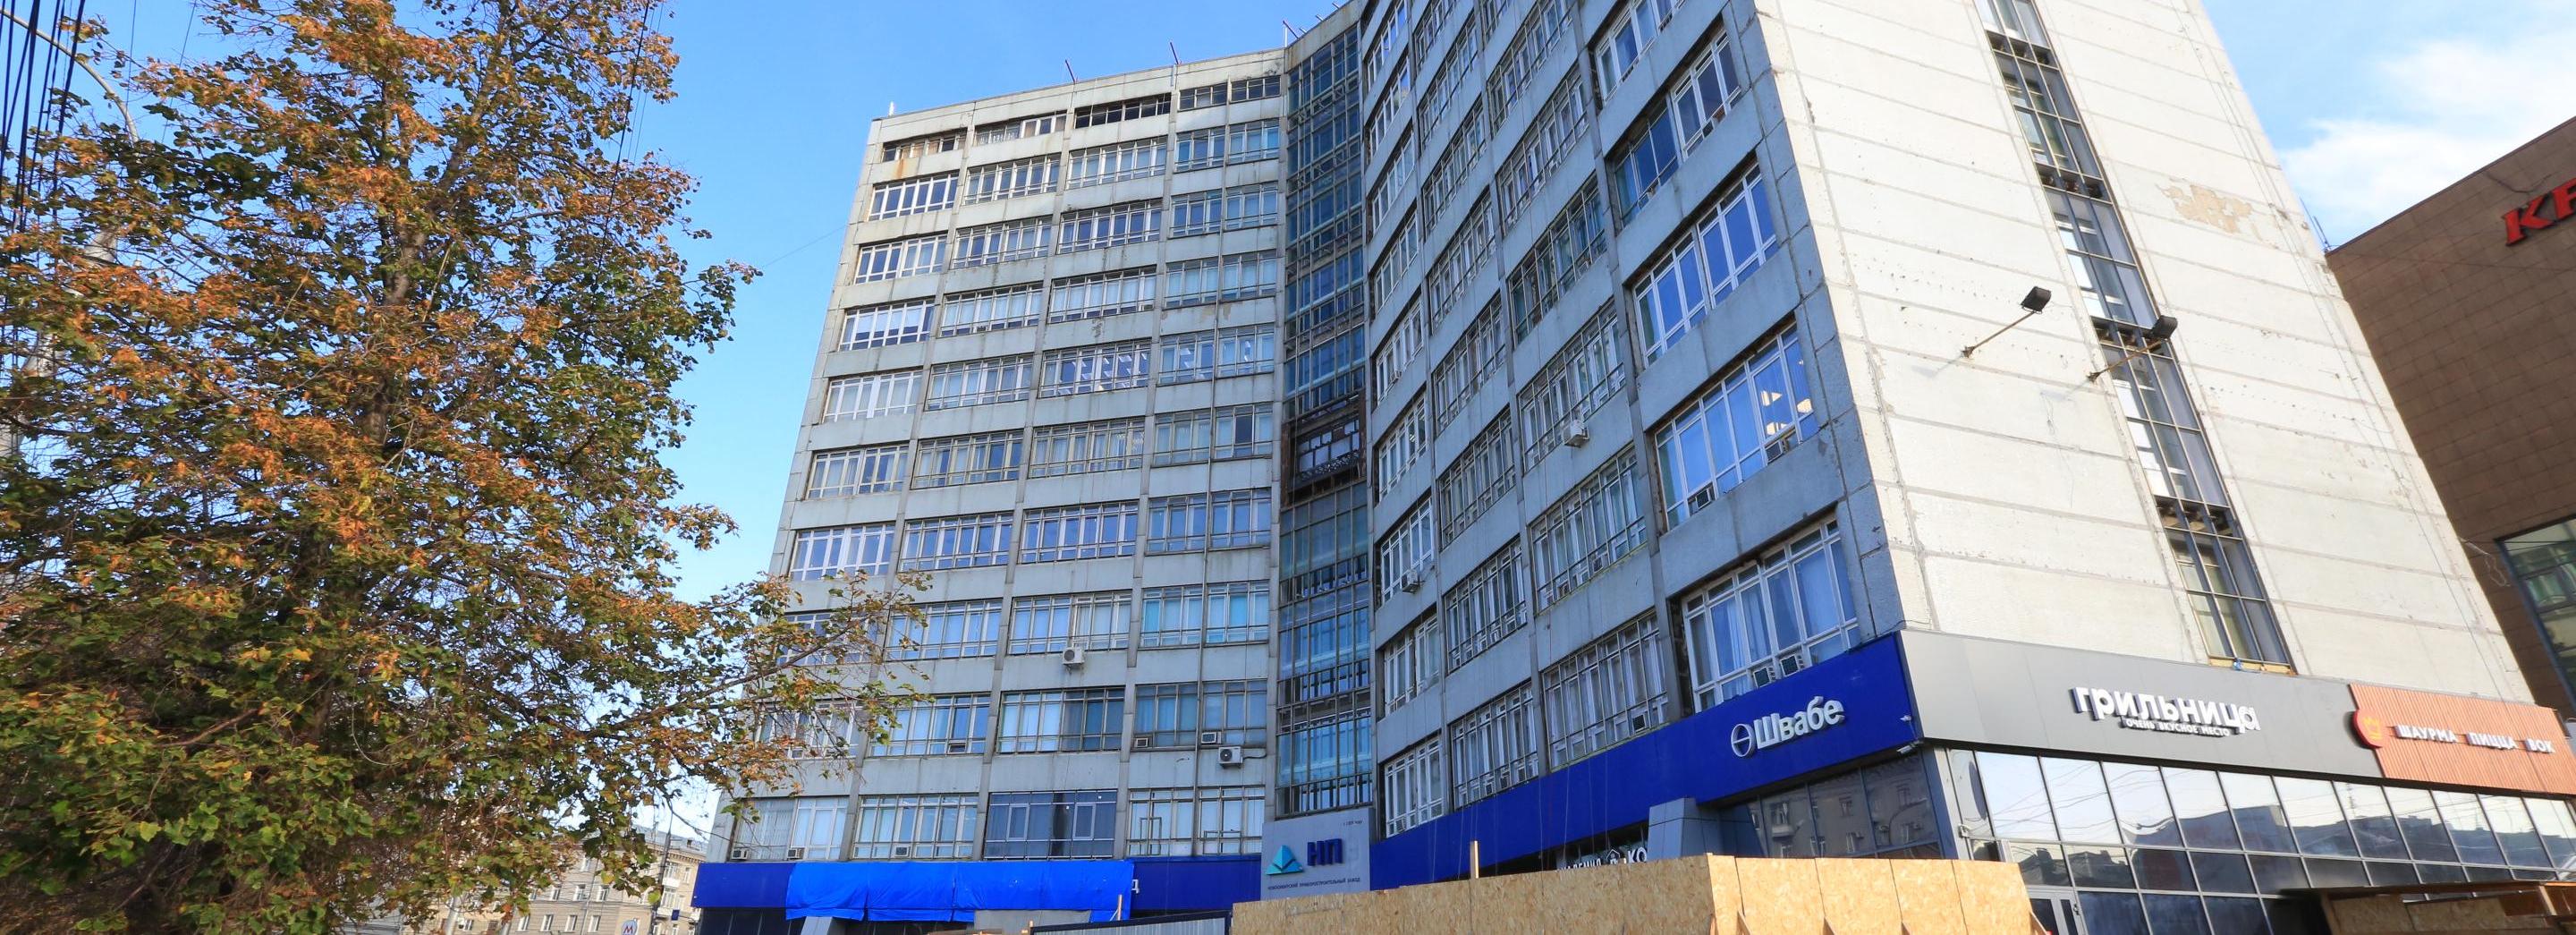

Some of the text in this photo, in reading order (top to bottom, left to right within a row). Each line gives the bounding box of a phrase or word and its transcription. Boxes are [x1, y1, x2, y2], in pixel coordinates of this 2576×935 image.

[1753, 695, 1845, 750] Швабе
[2123, 718, 2231, 737] ОЧЕНЬ ВКУСНОЕ МЕСТО
[2394, 724, 2555, 753] ШАУРМА ПИЦЦА ВОК
